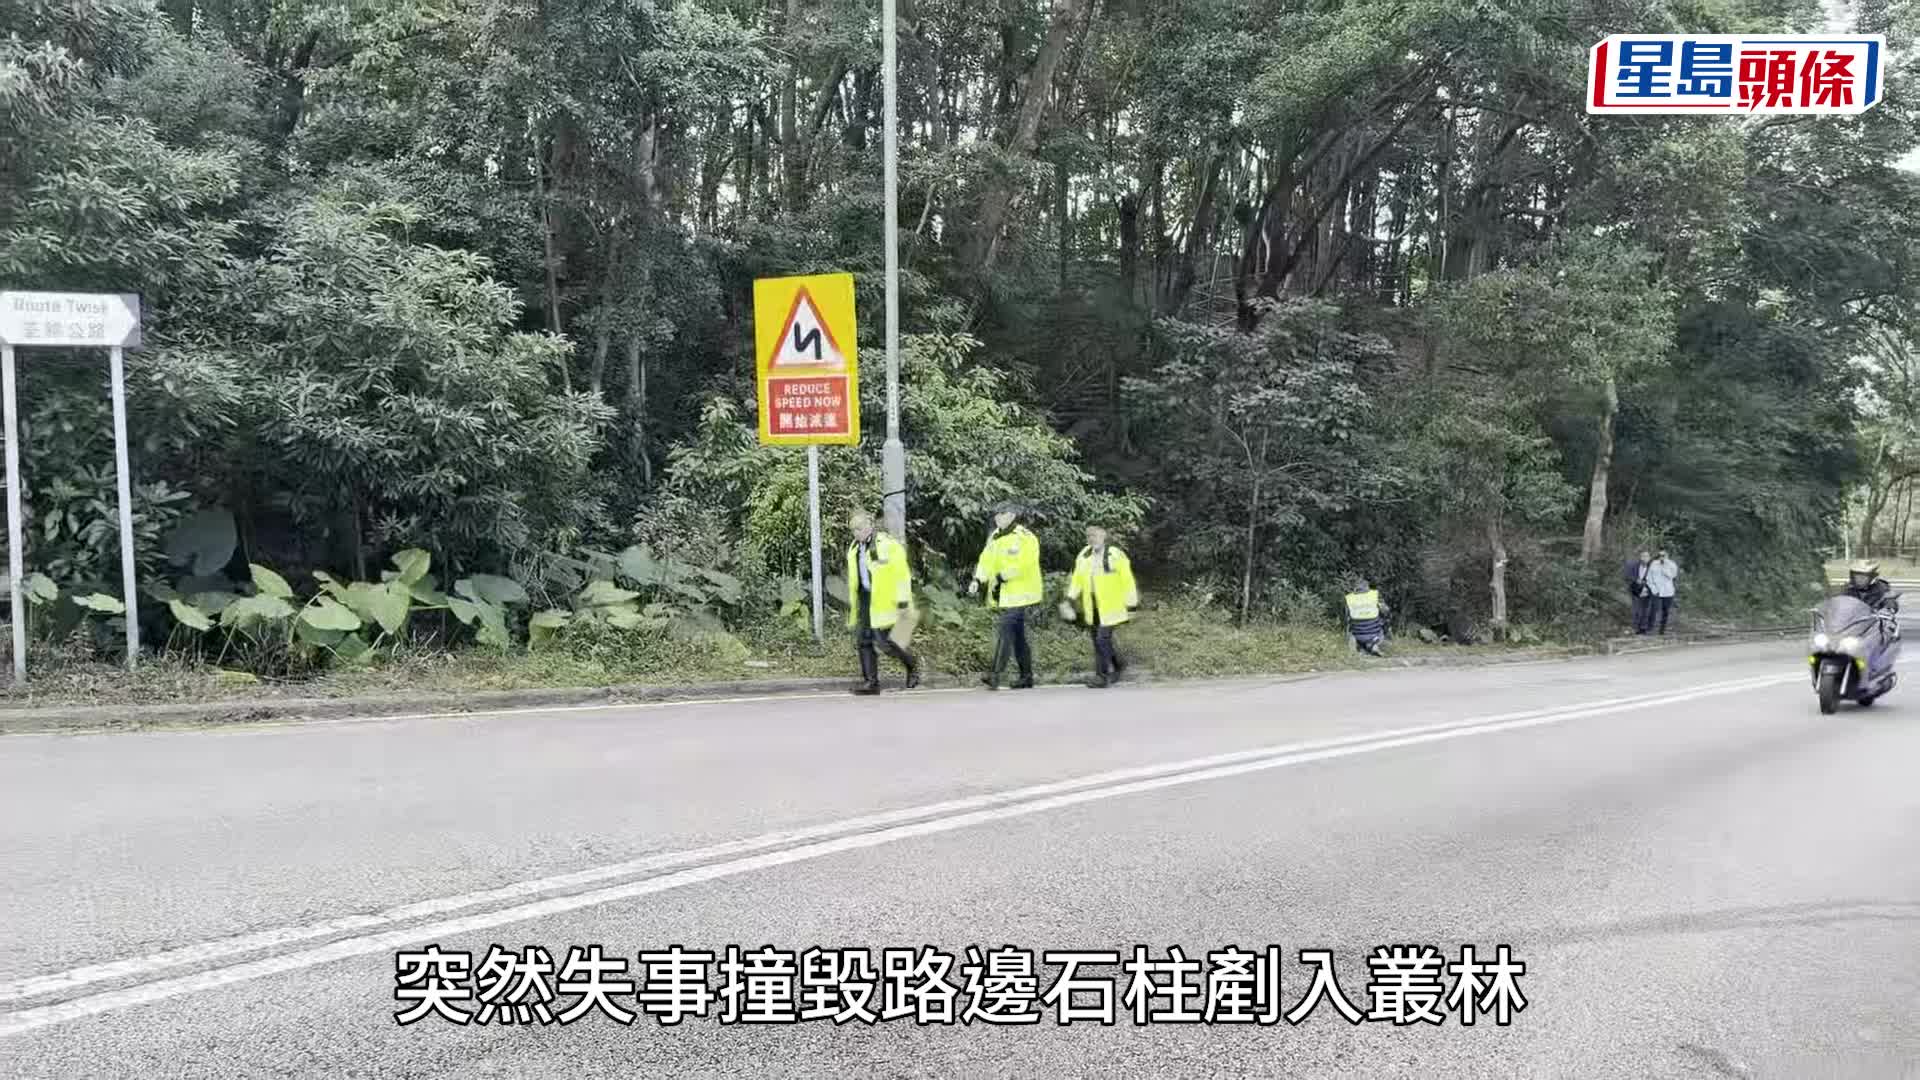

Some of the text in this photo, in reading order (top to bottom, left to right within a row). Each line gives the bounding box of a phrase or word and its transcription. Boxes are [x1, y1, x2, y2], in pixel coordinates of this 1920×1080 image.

[784, 383, 832, 395] REDUCE
[774, 395, 841, 408] SPEED NOW
